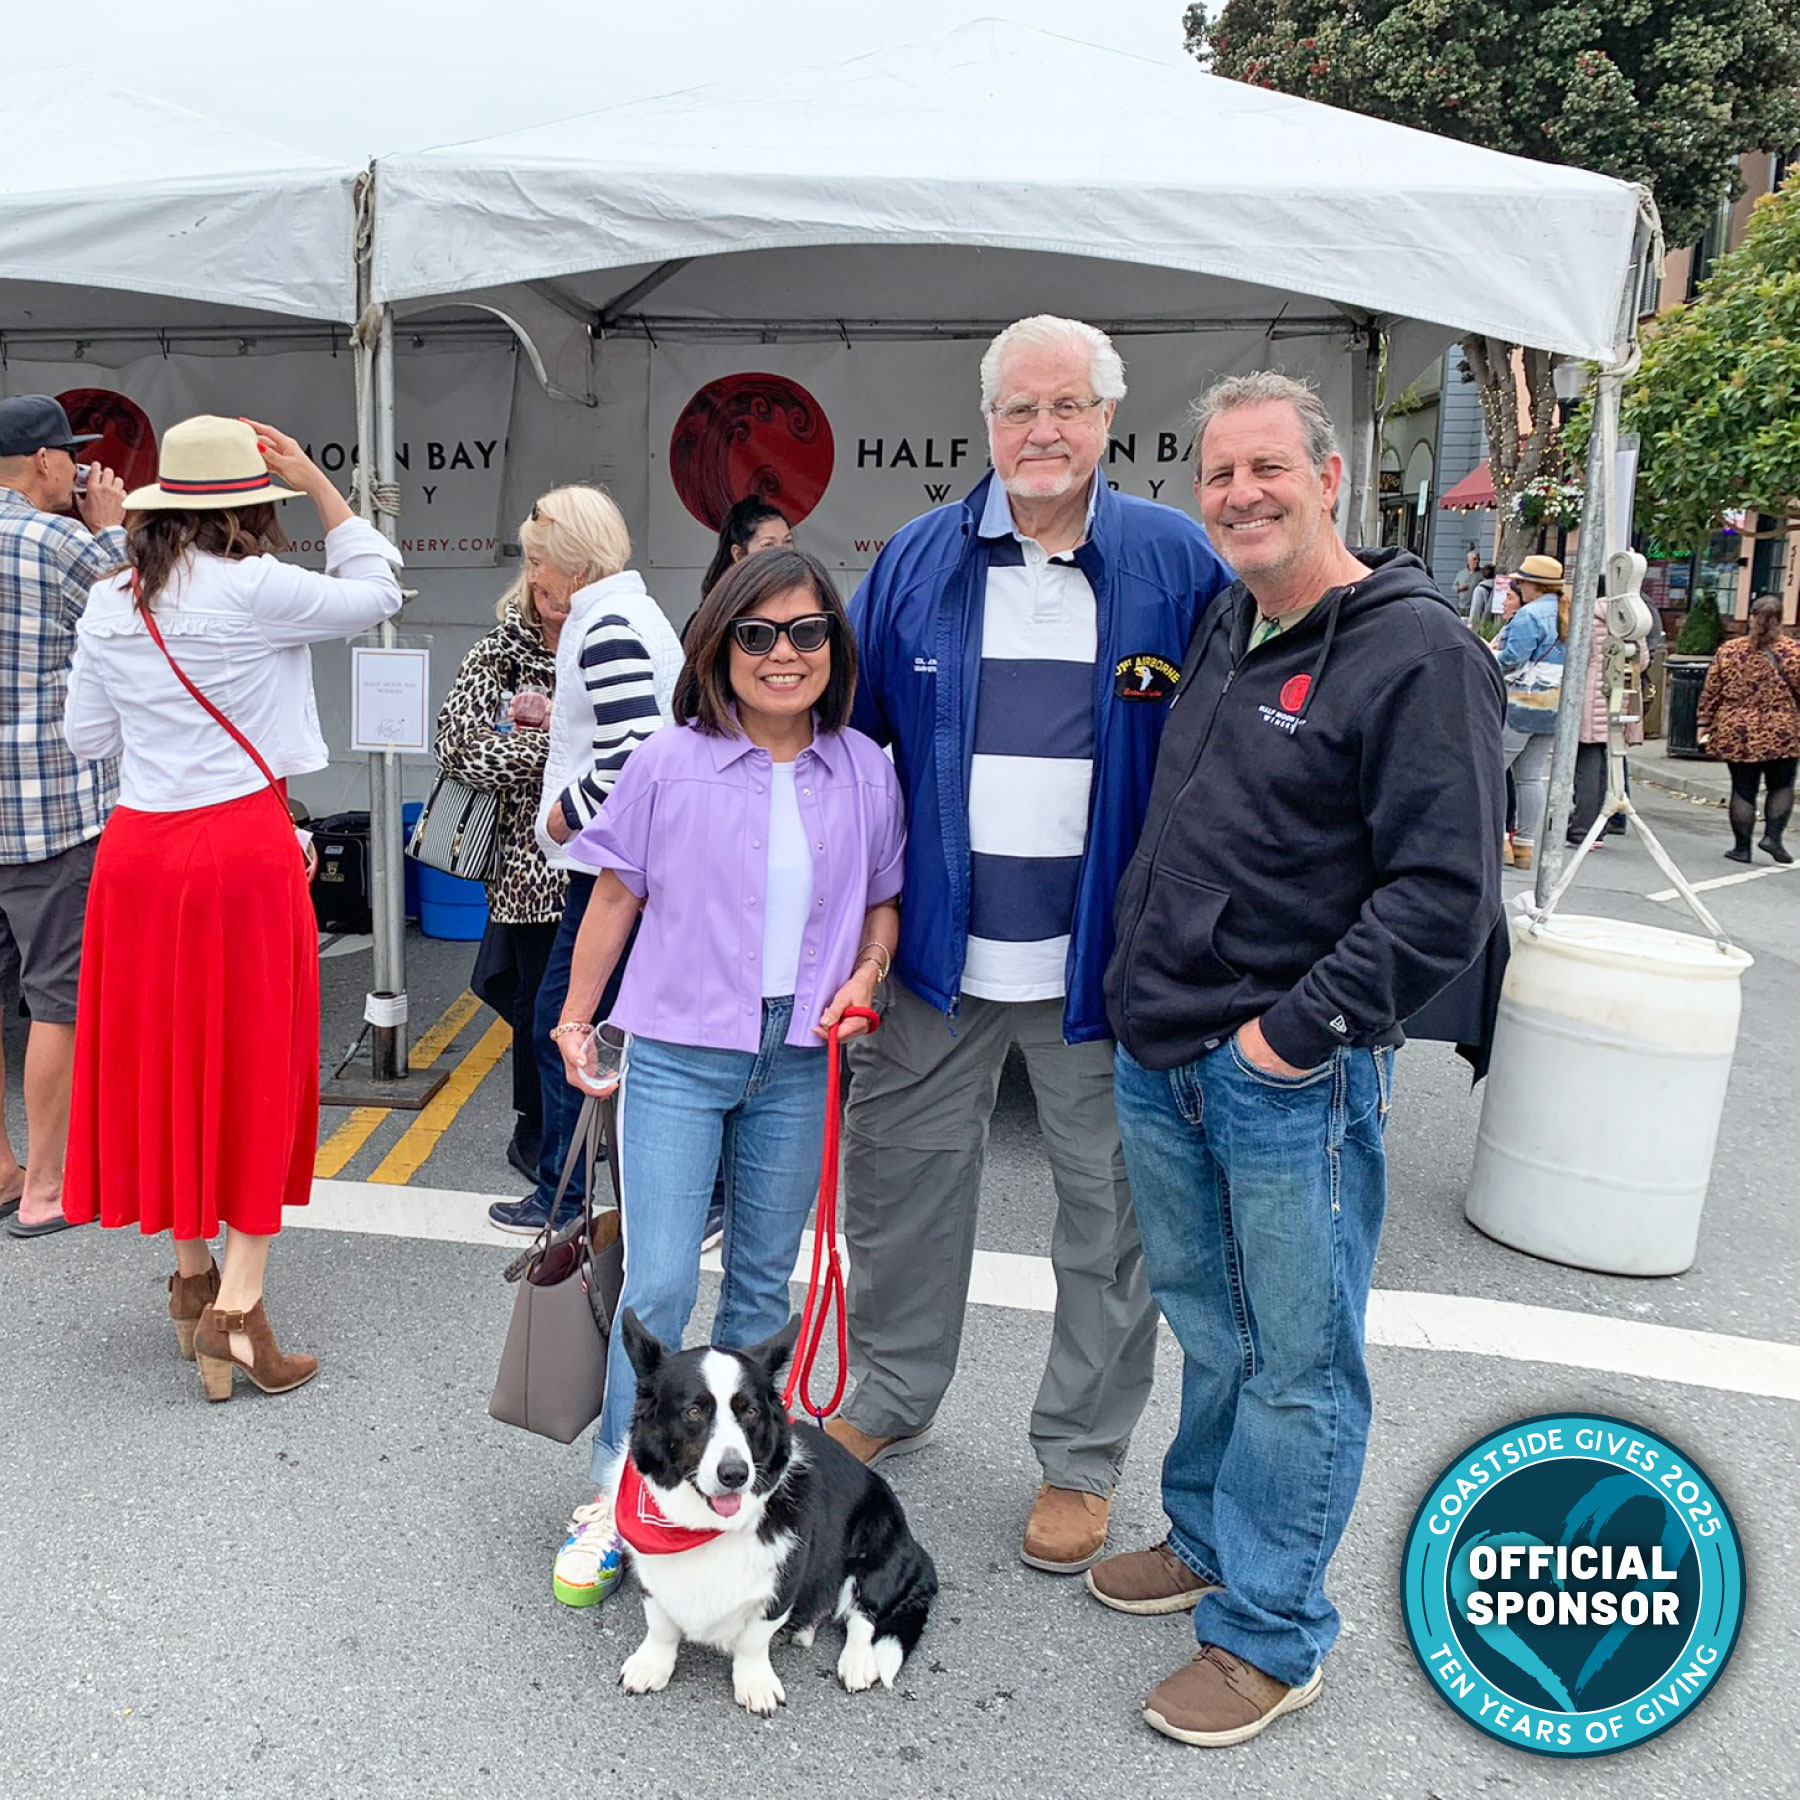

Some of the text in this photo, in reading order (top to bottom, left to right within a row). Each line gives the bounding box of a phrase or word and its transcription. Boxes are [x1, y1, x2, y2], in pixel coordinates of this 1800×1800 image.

[428, 440, 498, 470] BAY
[857, 438, 968, 468] HALF
[1135, 656, 1181, 684] AIRBORNE
